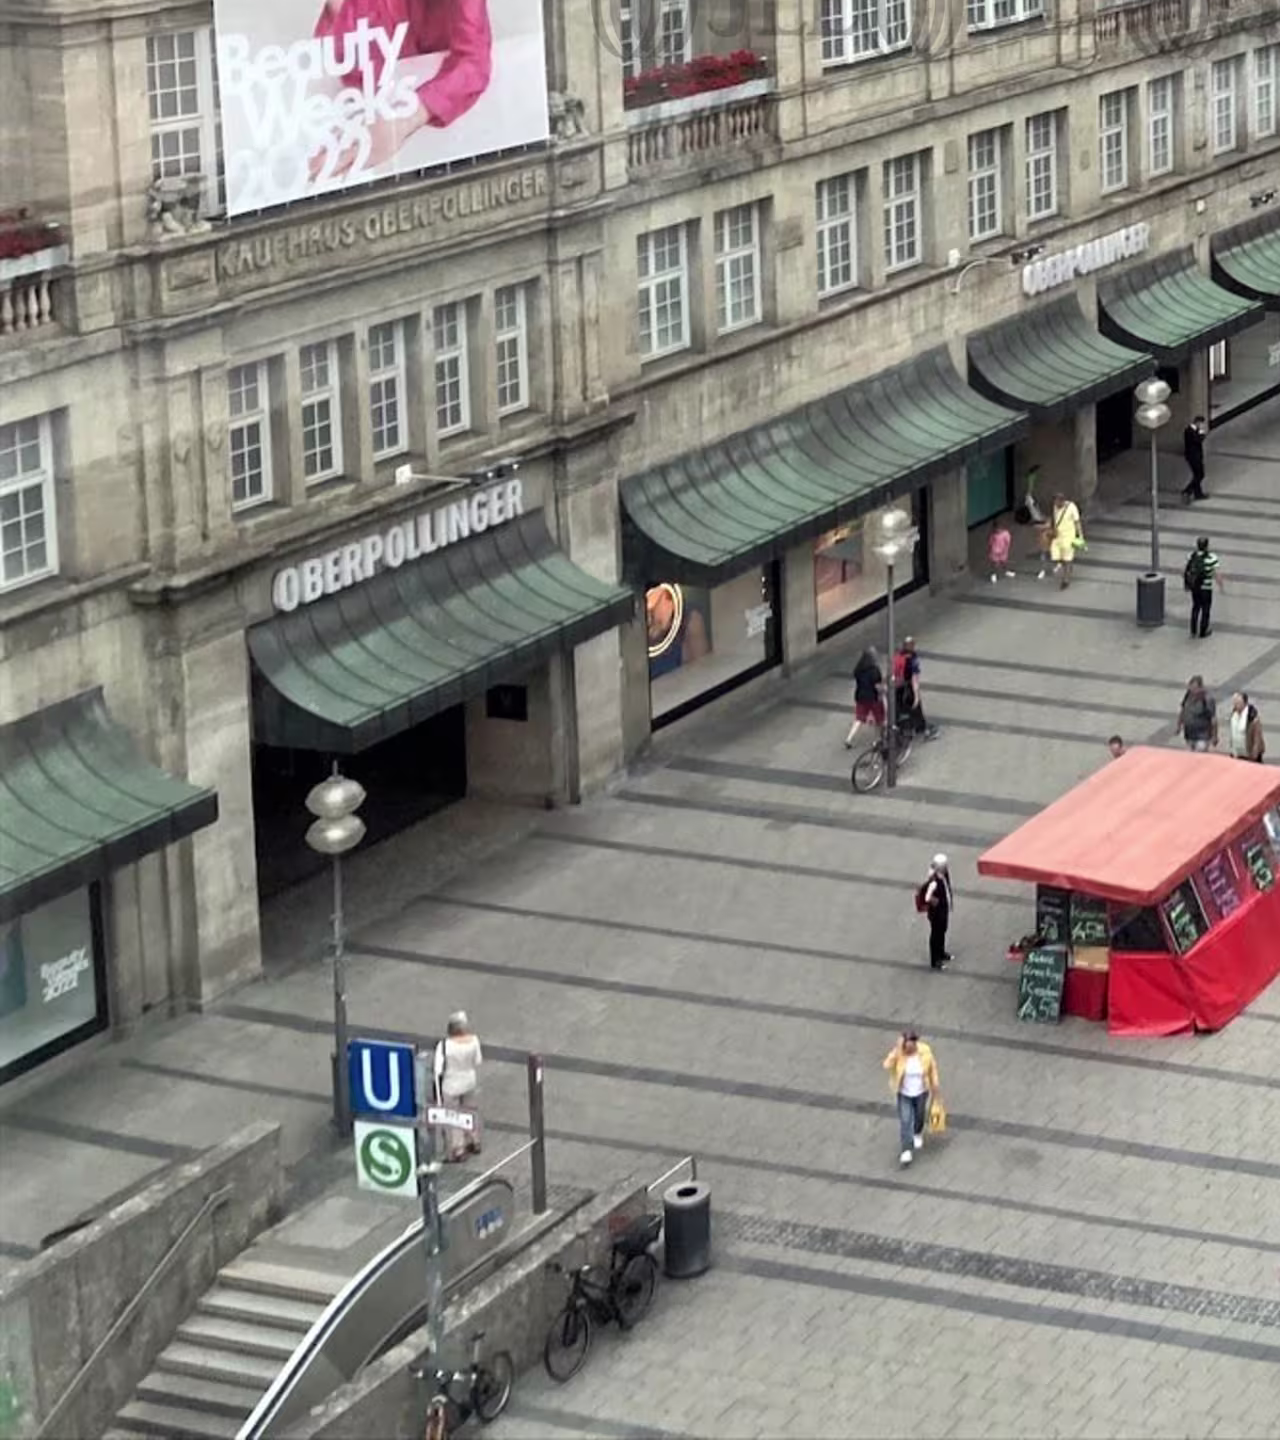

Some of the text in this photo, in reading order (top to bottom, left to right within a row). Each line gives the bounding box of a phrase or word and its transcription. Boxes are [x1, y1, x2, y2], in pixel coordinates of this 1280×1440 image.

[219, 18, 410, 95] Beauty
[239, 59, 421, 149] Weeks
[228, 121, 377, 211] 2022
[363, 170, 547, 241] OBERPOLLINGER
[272, 479, 525, 612] OBERPOLLINGER
[361, 1048, 401, 1110] U
[368, 1137, 402, 1182] S
